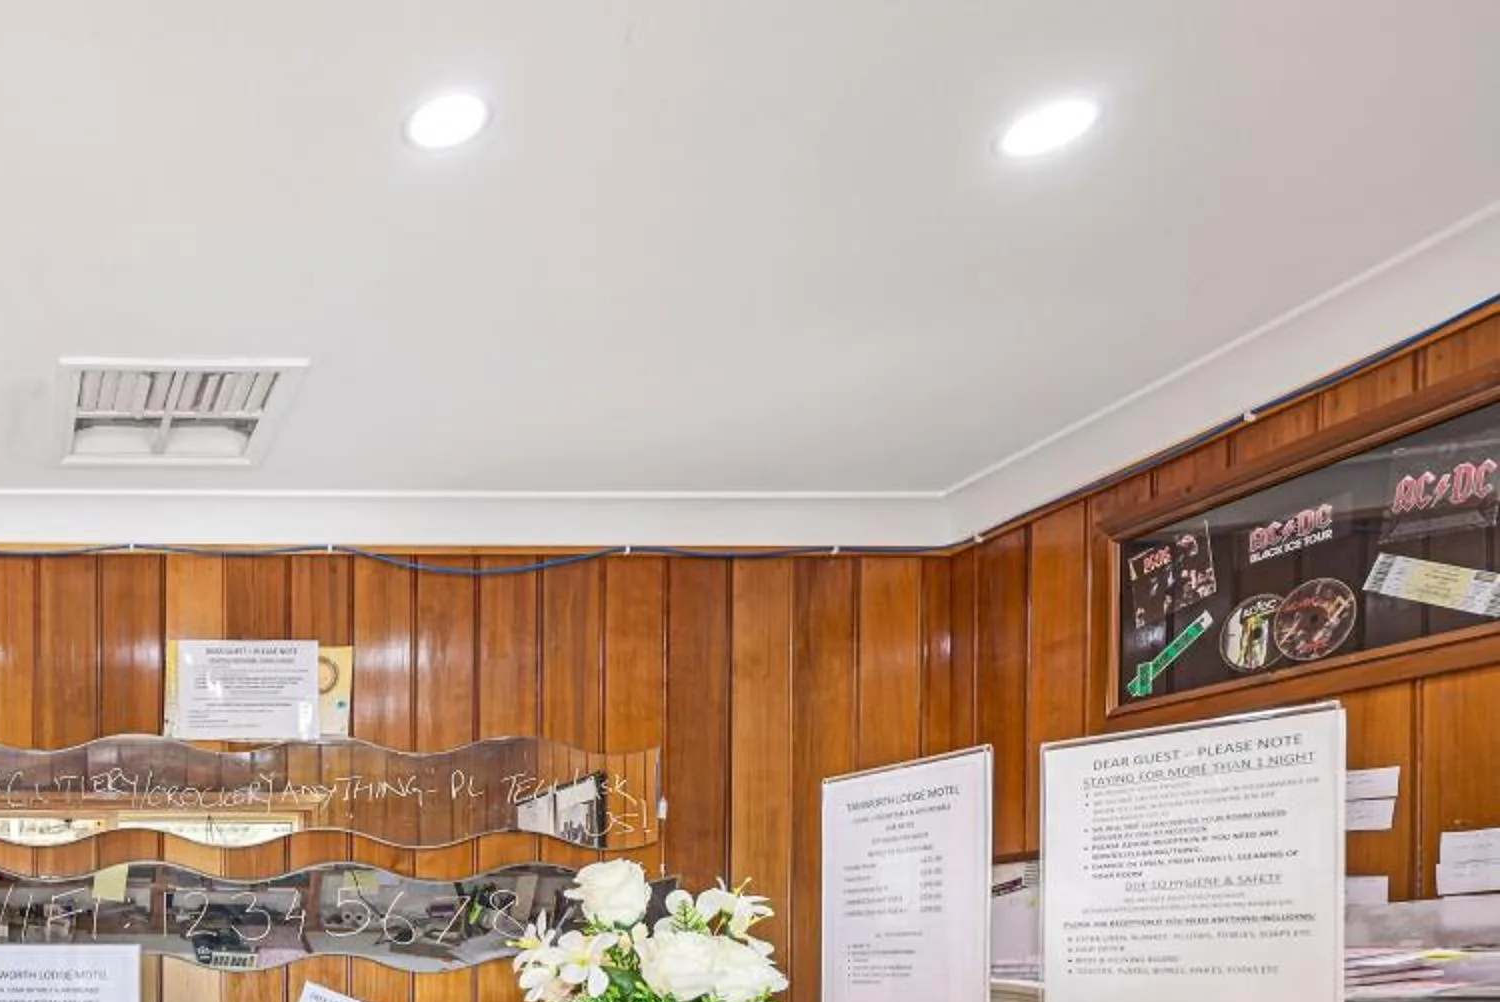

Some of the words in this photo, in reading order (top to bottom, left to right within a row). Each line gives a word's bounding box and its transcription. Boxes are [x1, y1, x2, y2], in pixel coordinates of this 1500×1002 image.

[1304, 529, 1333, 546] TOUR
[1093, 756, 1129, 772] DEAR
[1133, 749, 1180, 766] GUEST
[1197, 738, 1253, 757] PLEASE
[1257, 733, 1303, 750] NOTE
[1083, 774, 1136, 790] STAYING
[1138, 770, 1164, 784] FOR
[1167, 764, 1208, 780] MORE
[1211, 760, 1251, 776] THAN
[1268, 751, 1317, 768] NIGHT
[927, 784, 961, 799] MOTEL
[1237, 873, 1284, 888] SAFETY
